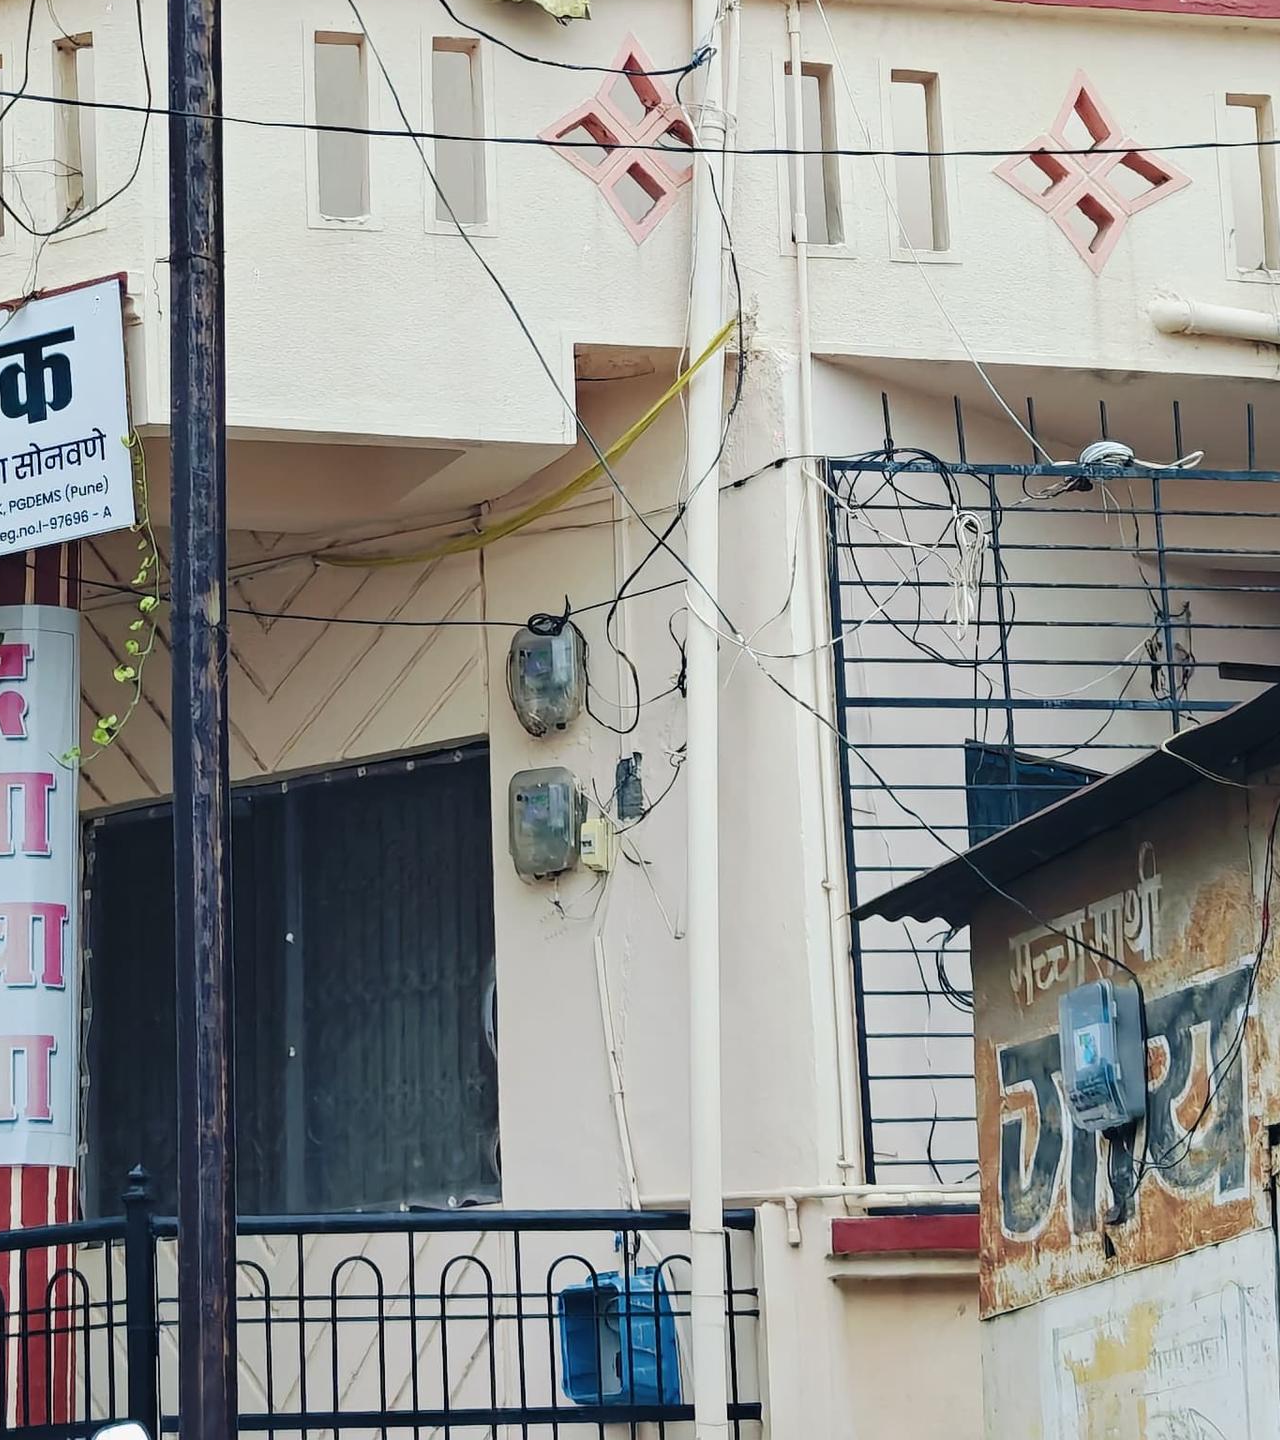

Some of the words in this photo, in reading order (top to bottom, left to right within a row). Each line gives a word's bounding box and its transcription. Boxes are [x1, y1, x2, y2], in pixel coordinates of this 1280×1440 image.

[11, 428, 107, 480] सोनवणे
[9, 489, 62, 513] PGDEMS
[65, 475, 109, 502] (Pune)
[103, 505, 113, 519] A
